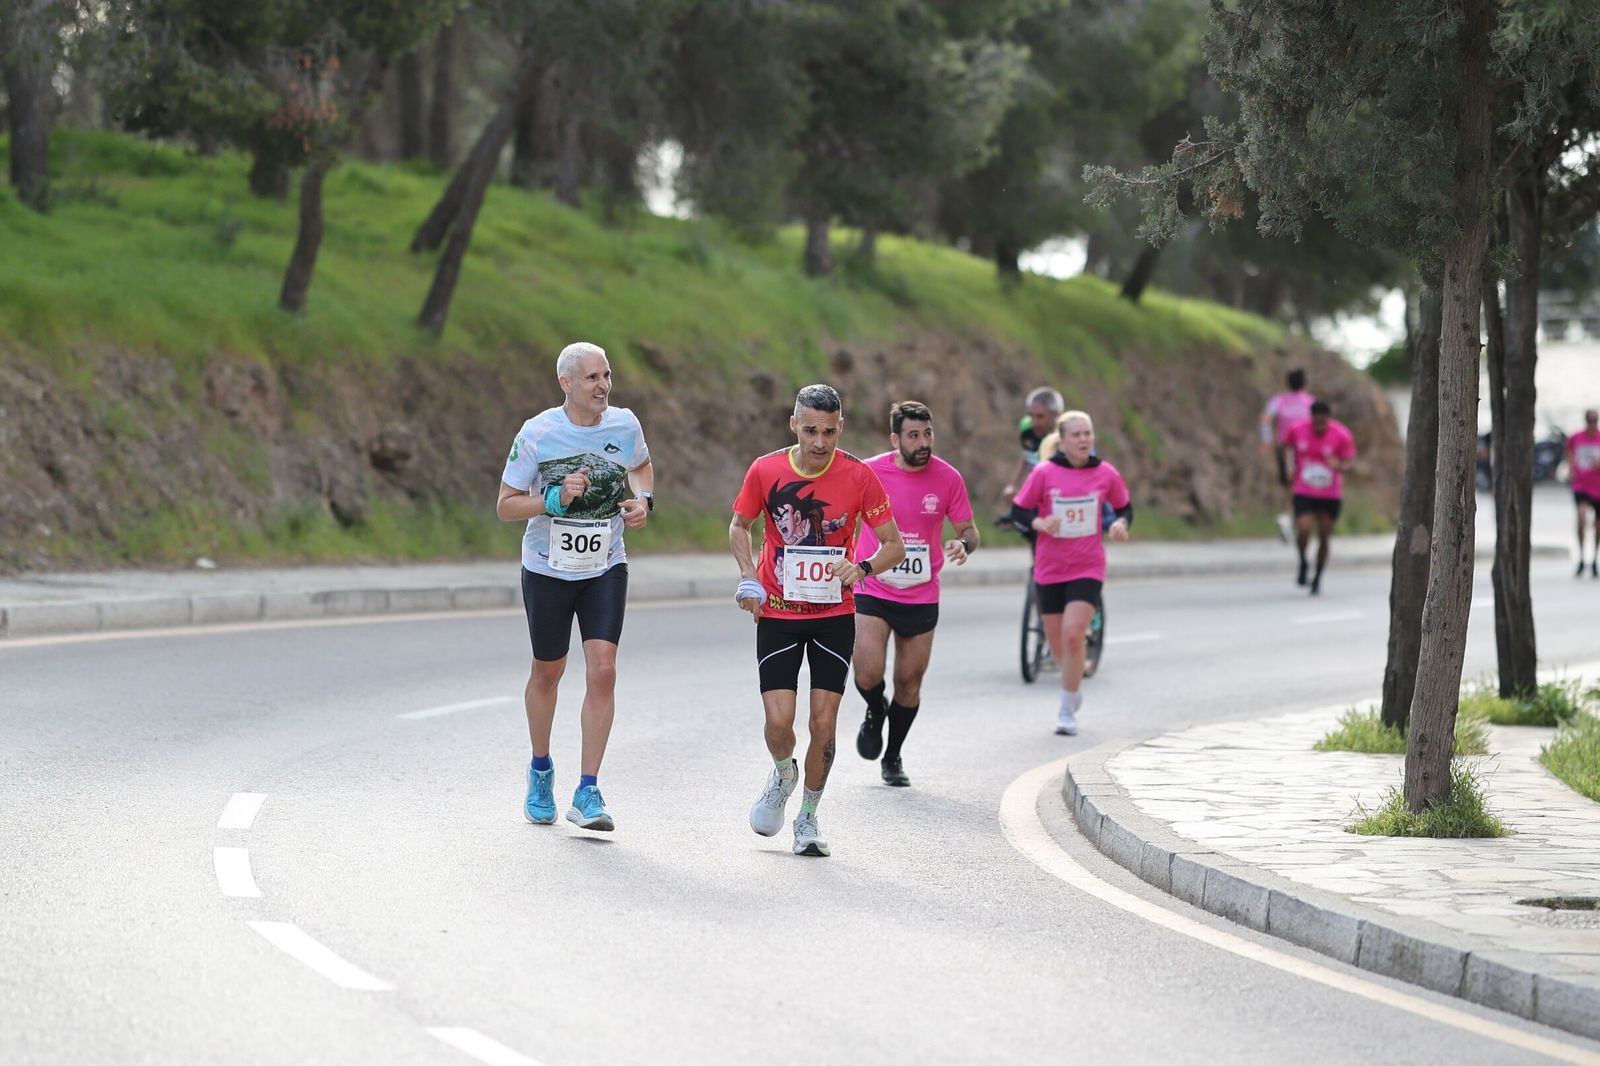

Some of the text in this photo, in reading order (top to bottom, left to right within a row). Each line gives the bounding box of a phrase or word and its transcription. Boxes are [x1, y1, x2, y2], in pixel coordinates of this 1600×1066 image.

[1066, 509, 1085, 523] 91
[560, 532, 602, 553] 306
[796, 561, 835, 582] 109
